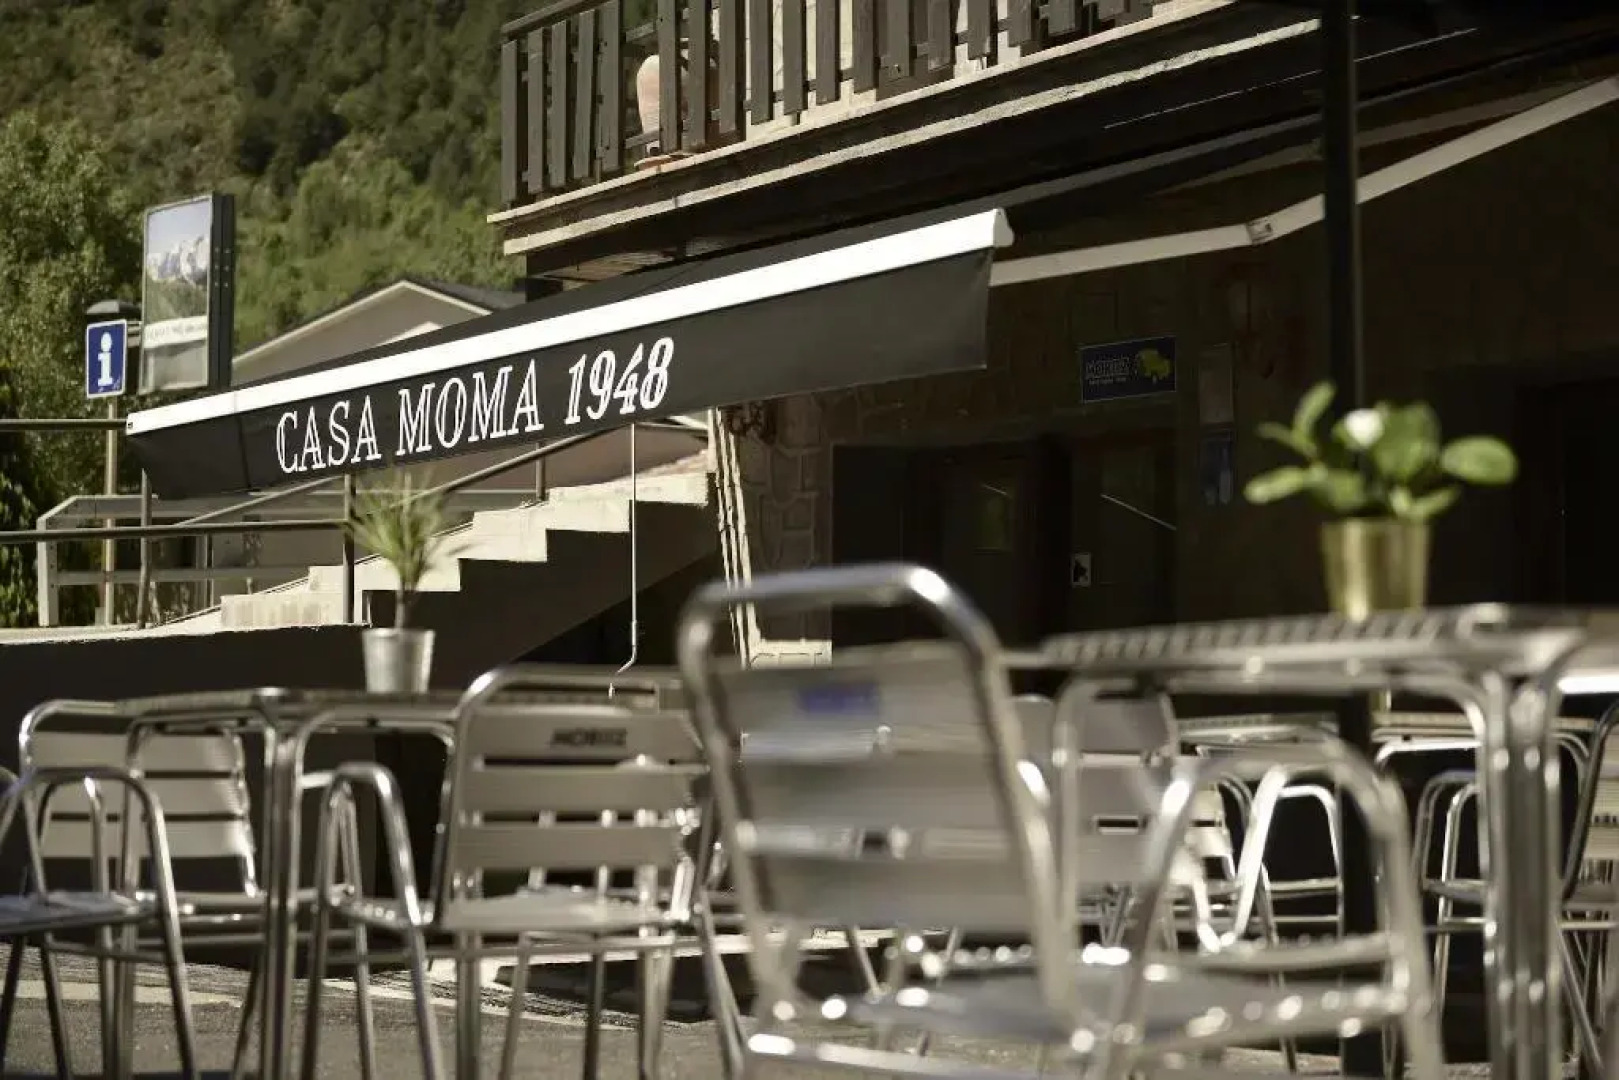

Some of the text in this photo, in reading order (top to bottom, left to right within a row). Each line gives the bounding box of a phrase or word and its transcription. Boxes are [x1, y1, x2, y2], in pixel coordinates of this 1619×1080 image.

[276, 337, 674, 474] CASA MOMA 1948
